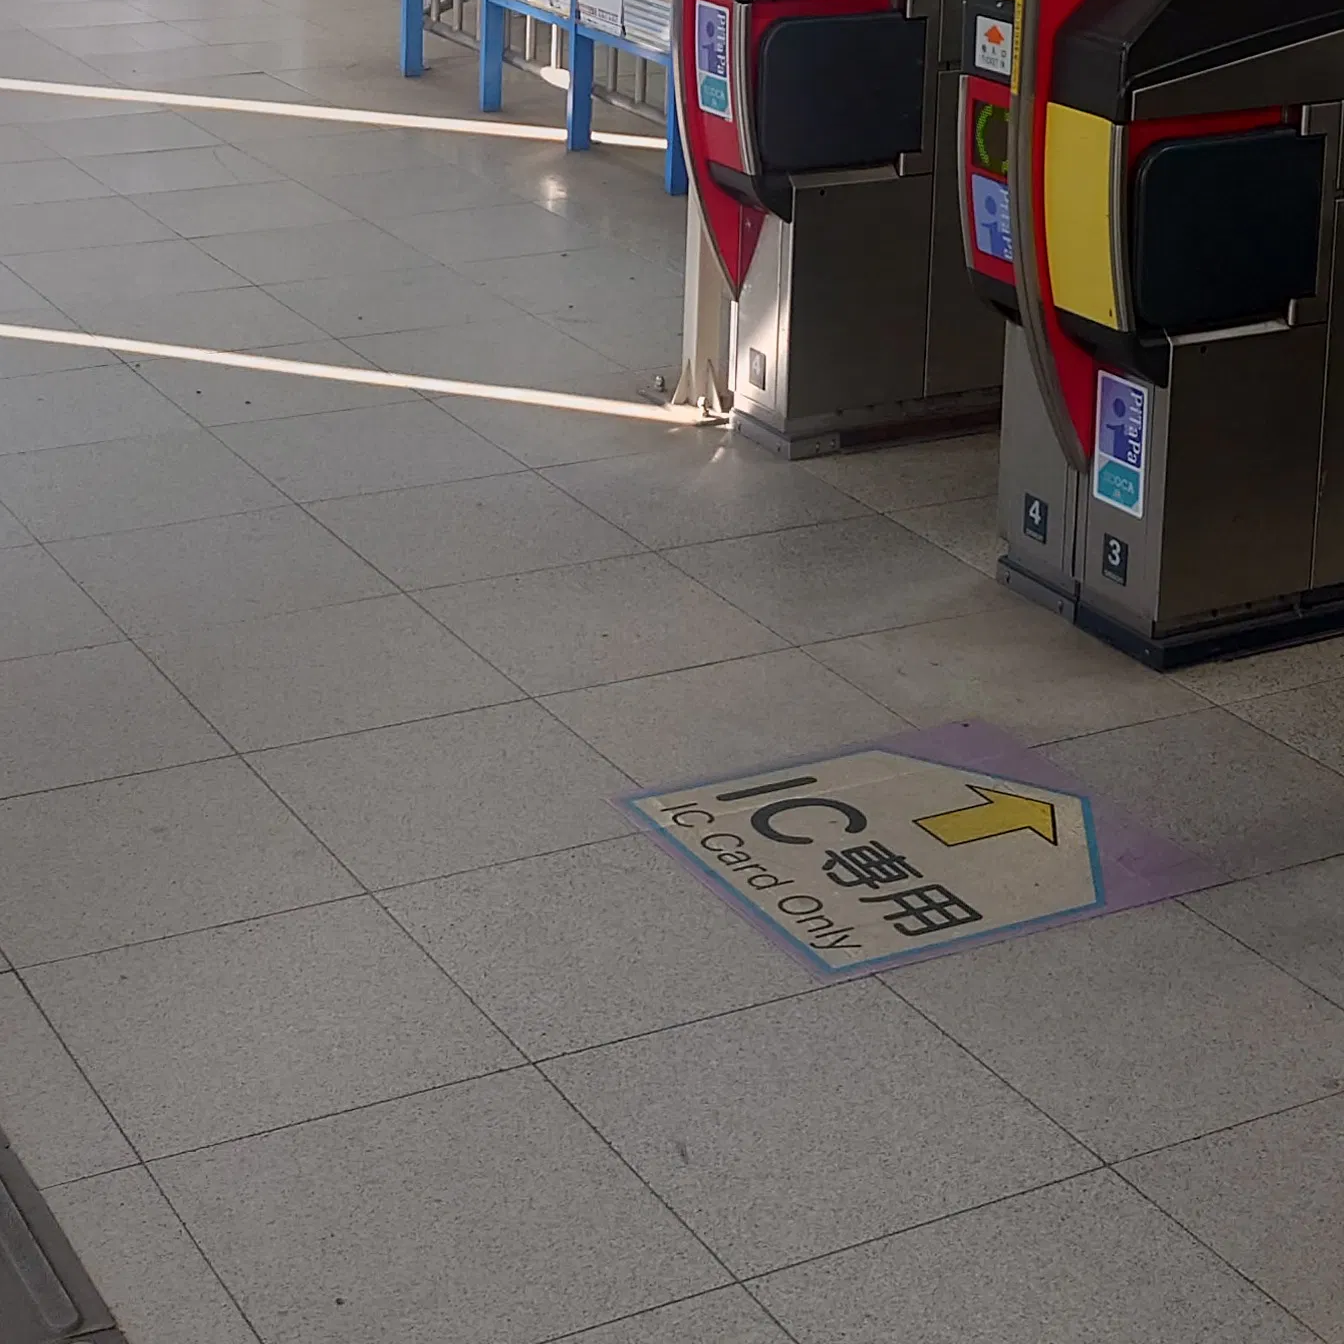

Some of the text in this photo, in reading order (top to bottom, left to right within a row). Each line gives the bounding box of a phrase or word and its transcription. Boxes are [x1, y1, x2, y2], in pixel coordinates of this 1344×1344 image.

[1126, 389, 1144, 465] PiTaPa
[1028, 499, 1042, 526] 4
[1107, 538, 1122, 566] 3
[659, 801, 862, 951] IC Card Only
[715, 775, 983, 937] IC専用
